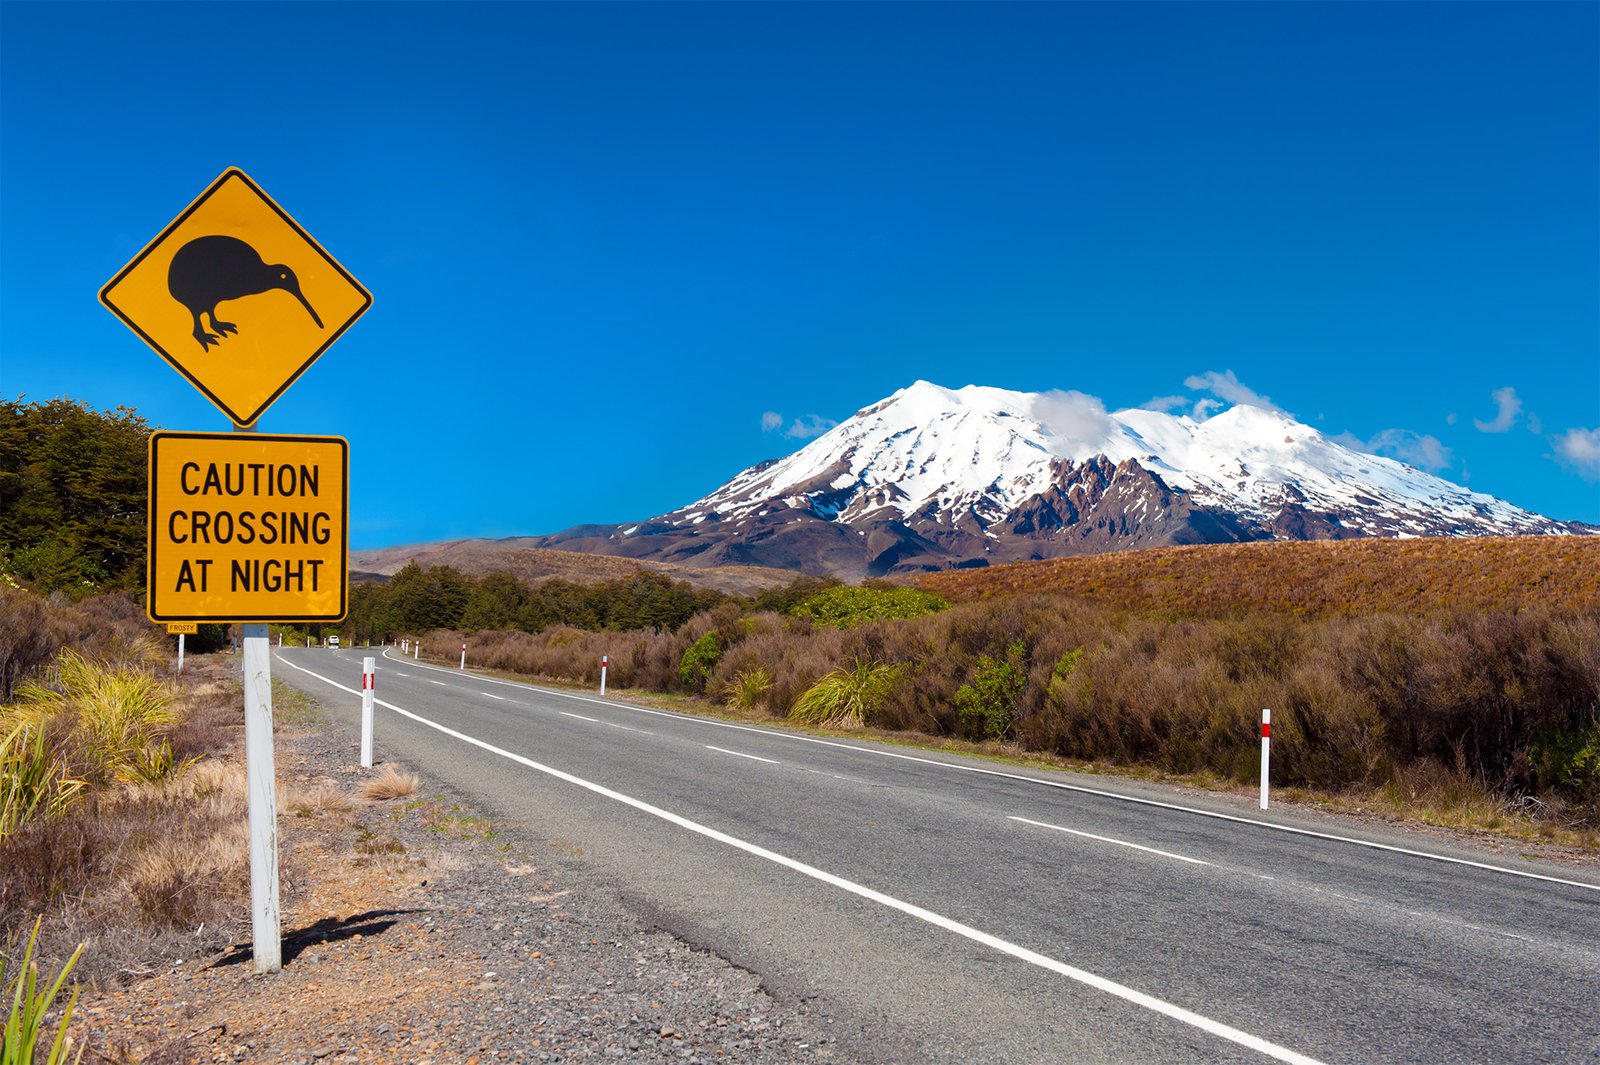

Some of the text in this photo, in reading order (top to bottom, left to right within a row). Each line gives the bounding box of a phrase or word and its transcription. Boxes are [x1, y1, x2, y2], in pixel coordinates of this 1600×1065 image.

[181, 462, 319, 497] CAUTION
[169, 511, 331, 544] CROSSING
[176, 560, 324, 592] AT NIGHT
